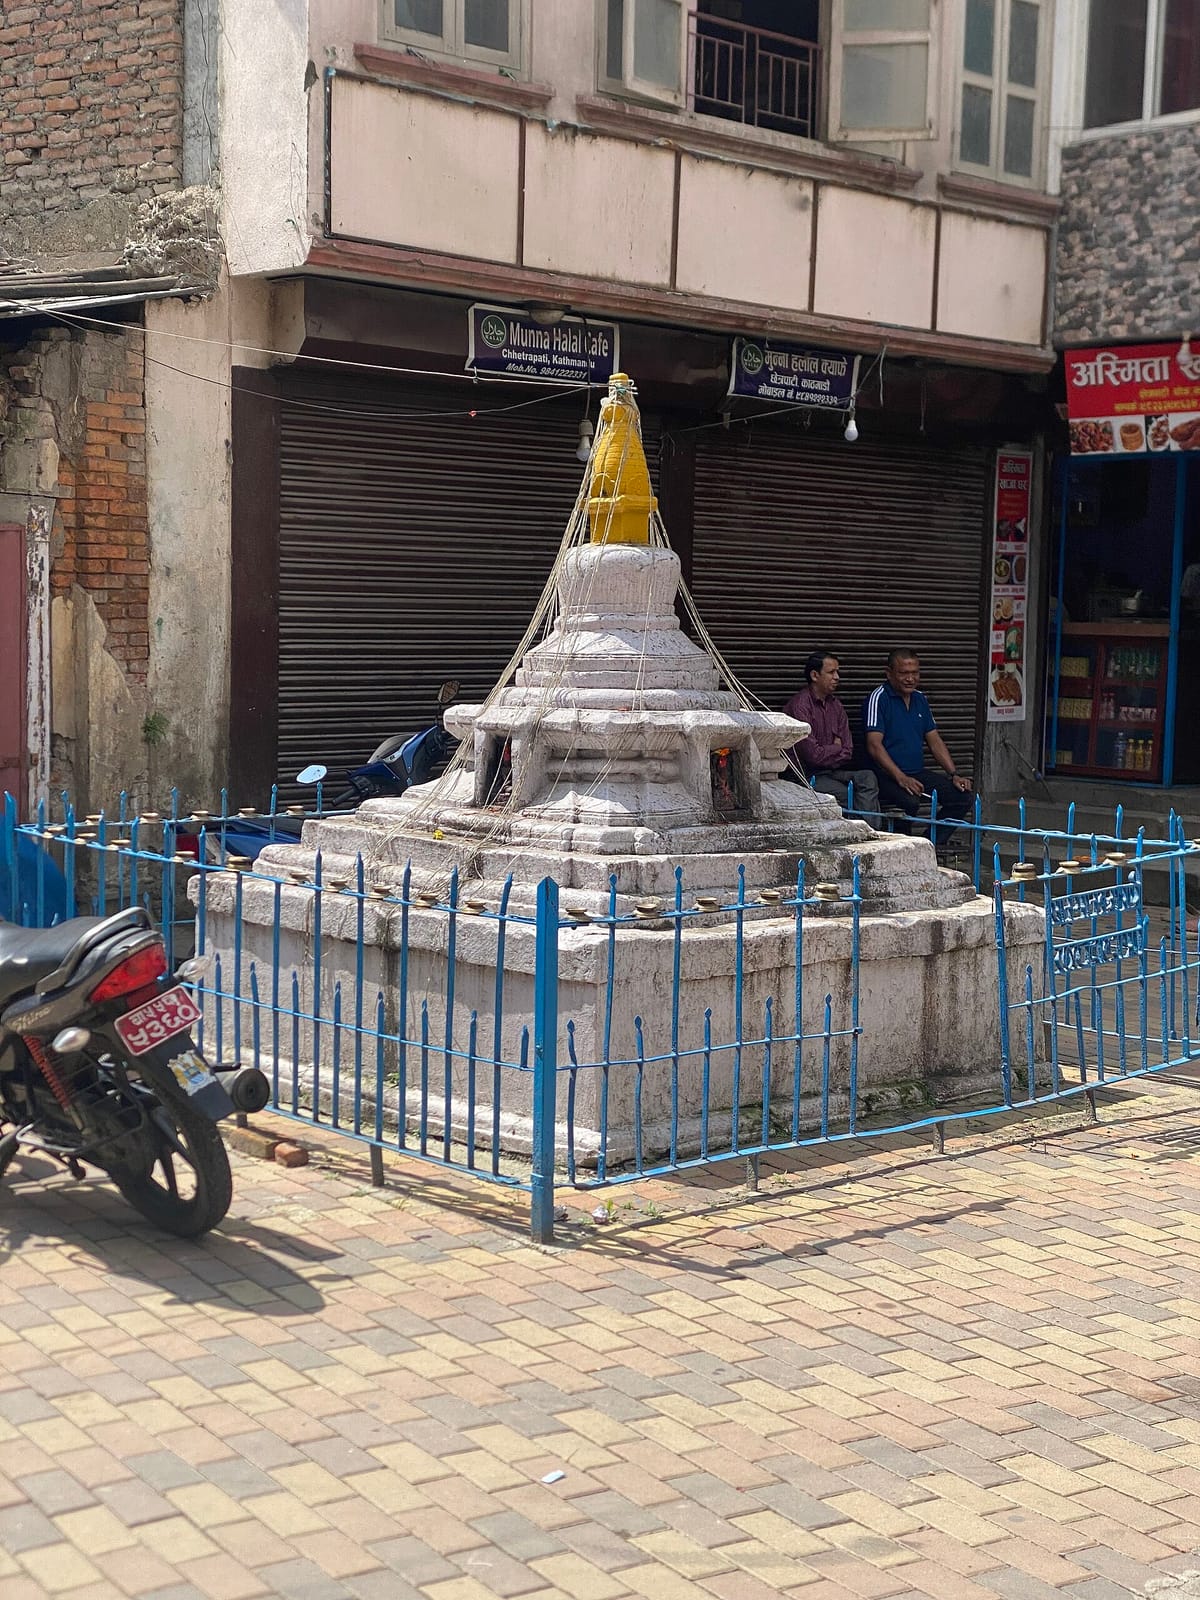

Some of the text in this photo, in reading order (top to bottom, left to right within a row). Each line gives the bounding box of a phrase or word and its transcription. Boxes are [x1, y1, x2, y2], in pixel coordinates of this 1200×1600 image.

[509, 321, 550, 350] Munna
[553, 328, 582, 354] Halal
[502, 348, 596, 369] Chhetrapati, Kathmanu
[764, 349, 789, 372] मुन्ना
[791, 354, 819, 374] हलाल
[1071, 352, 1171, 386] अस्मिता
[127, 1004, 196, 1046] ५३६०
